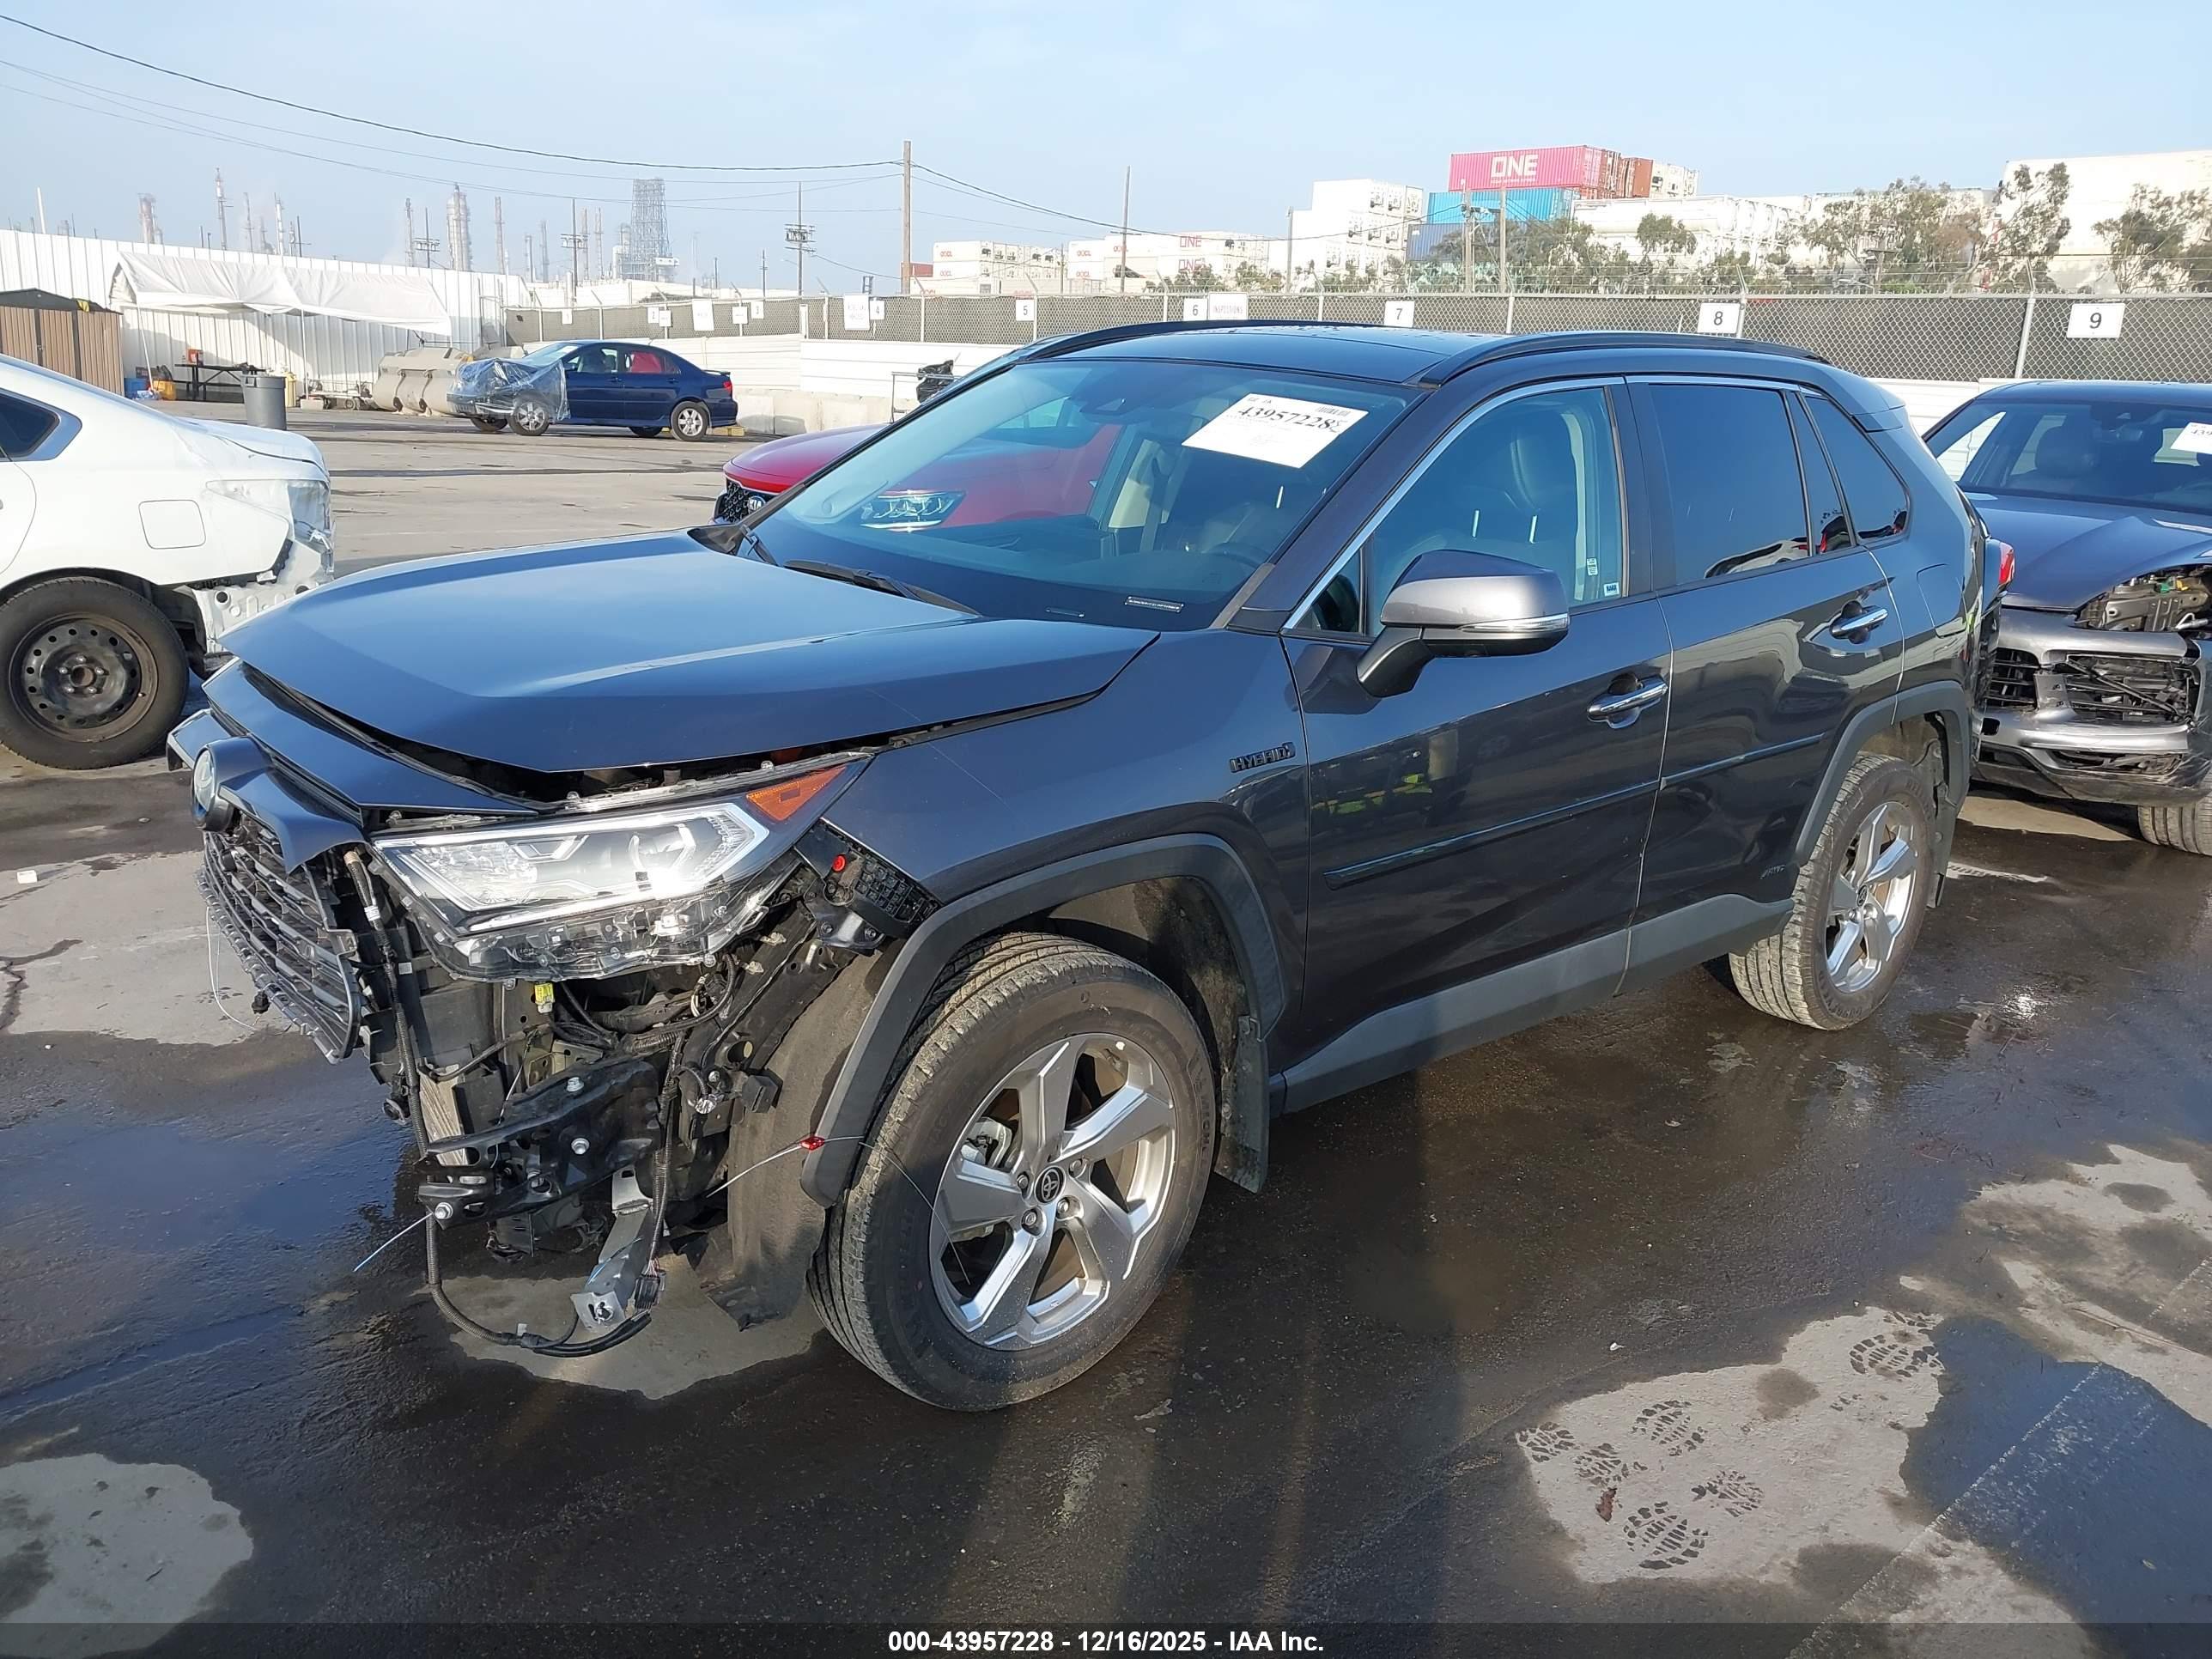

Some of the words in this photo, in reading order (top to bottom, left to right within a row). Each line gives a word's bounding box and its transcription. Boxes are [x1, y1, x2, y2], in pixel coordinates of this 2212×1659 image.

[1491, 155, 1538, 178] ONE
[1179, 234, 1202, 247] ONE
[1023, 305, 1029, 316] 5
[1192, 304, 1199, 317] 6
[1396, 307, 1403, 320] 7
[1713, 311, 1723, 326] 8
[2089, 312, 2102, 329] 9
[1237, 406, 1335, 429] 43957228
[749, 499, 763, 511] KIA
[1230, 746, 1288, 771] HYBRID
